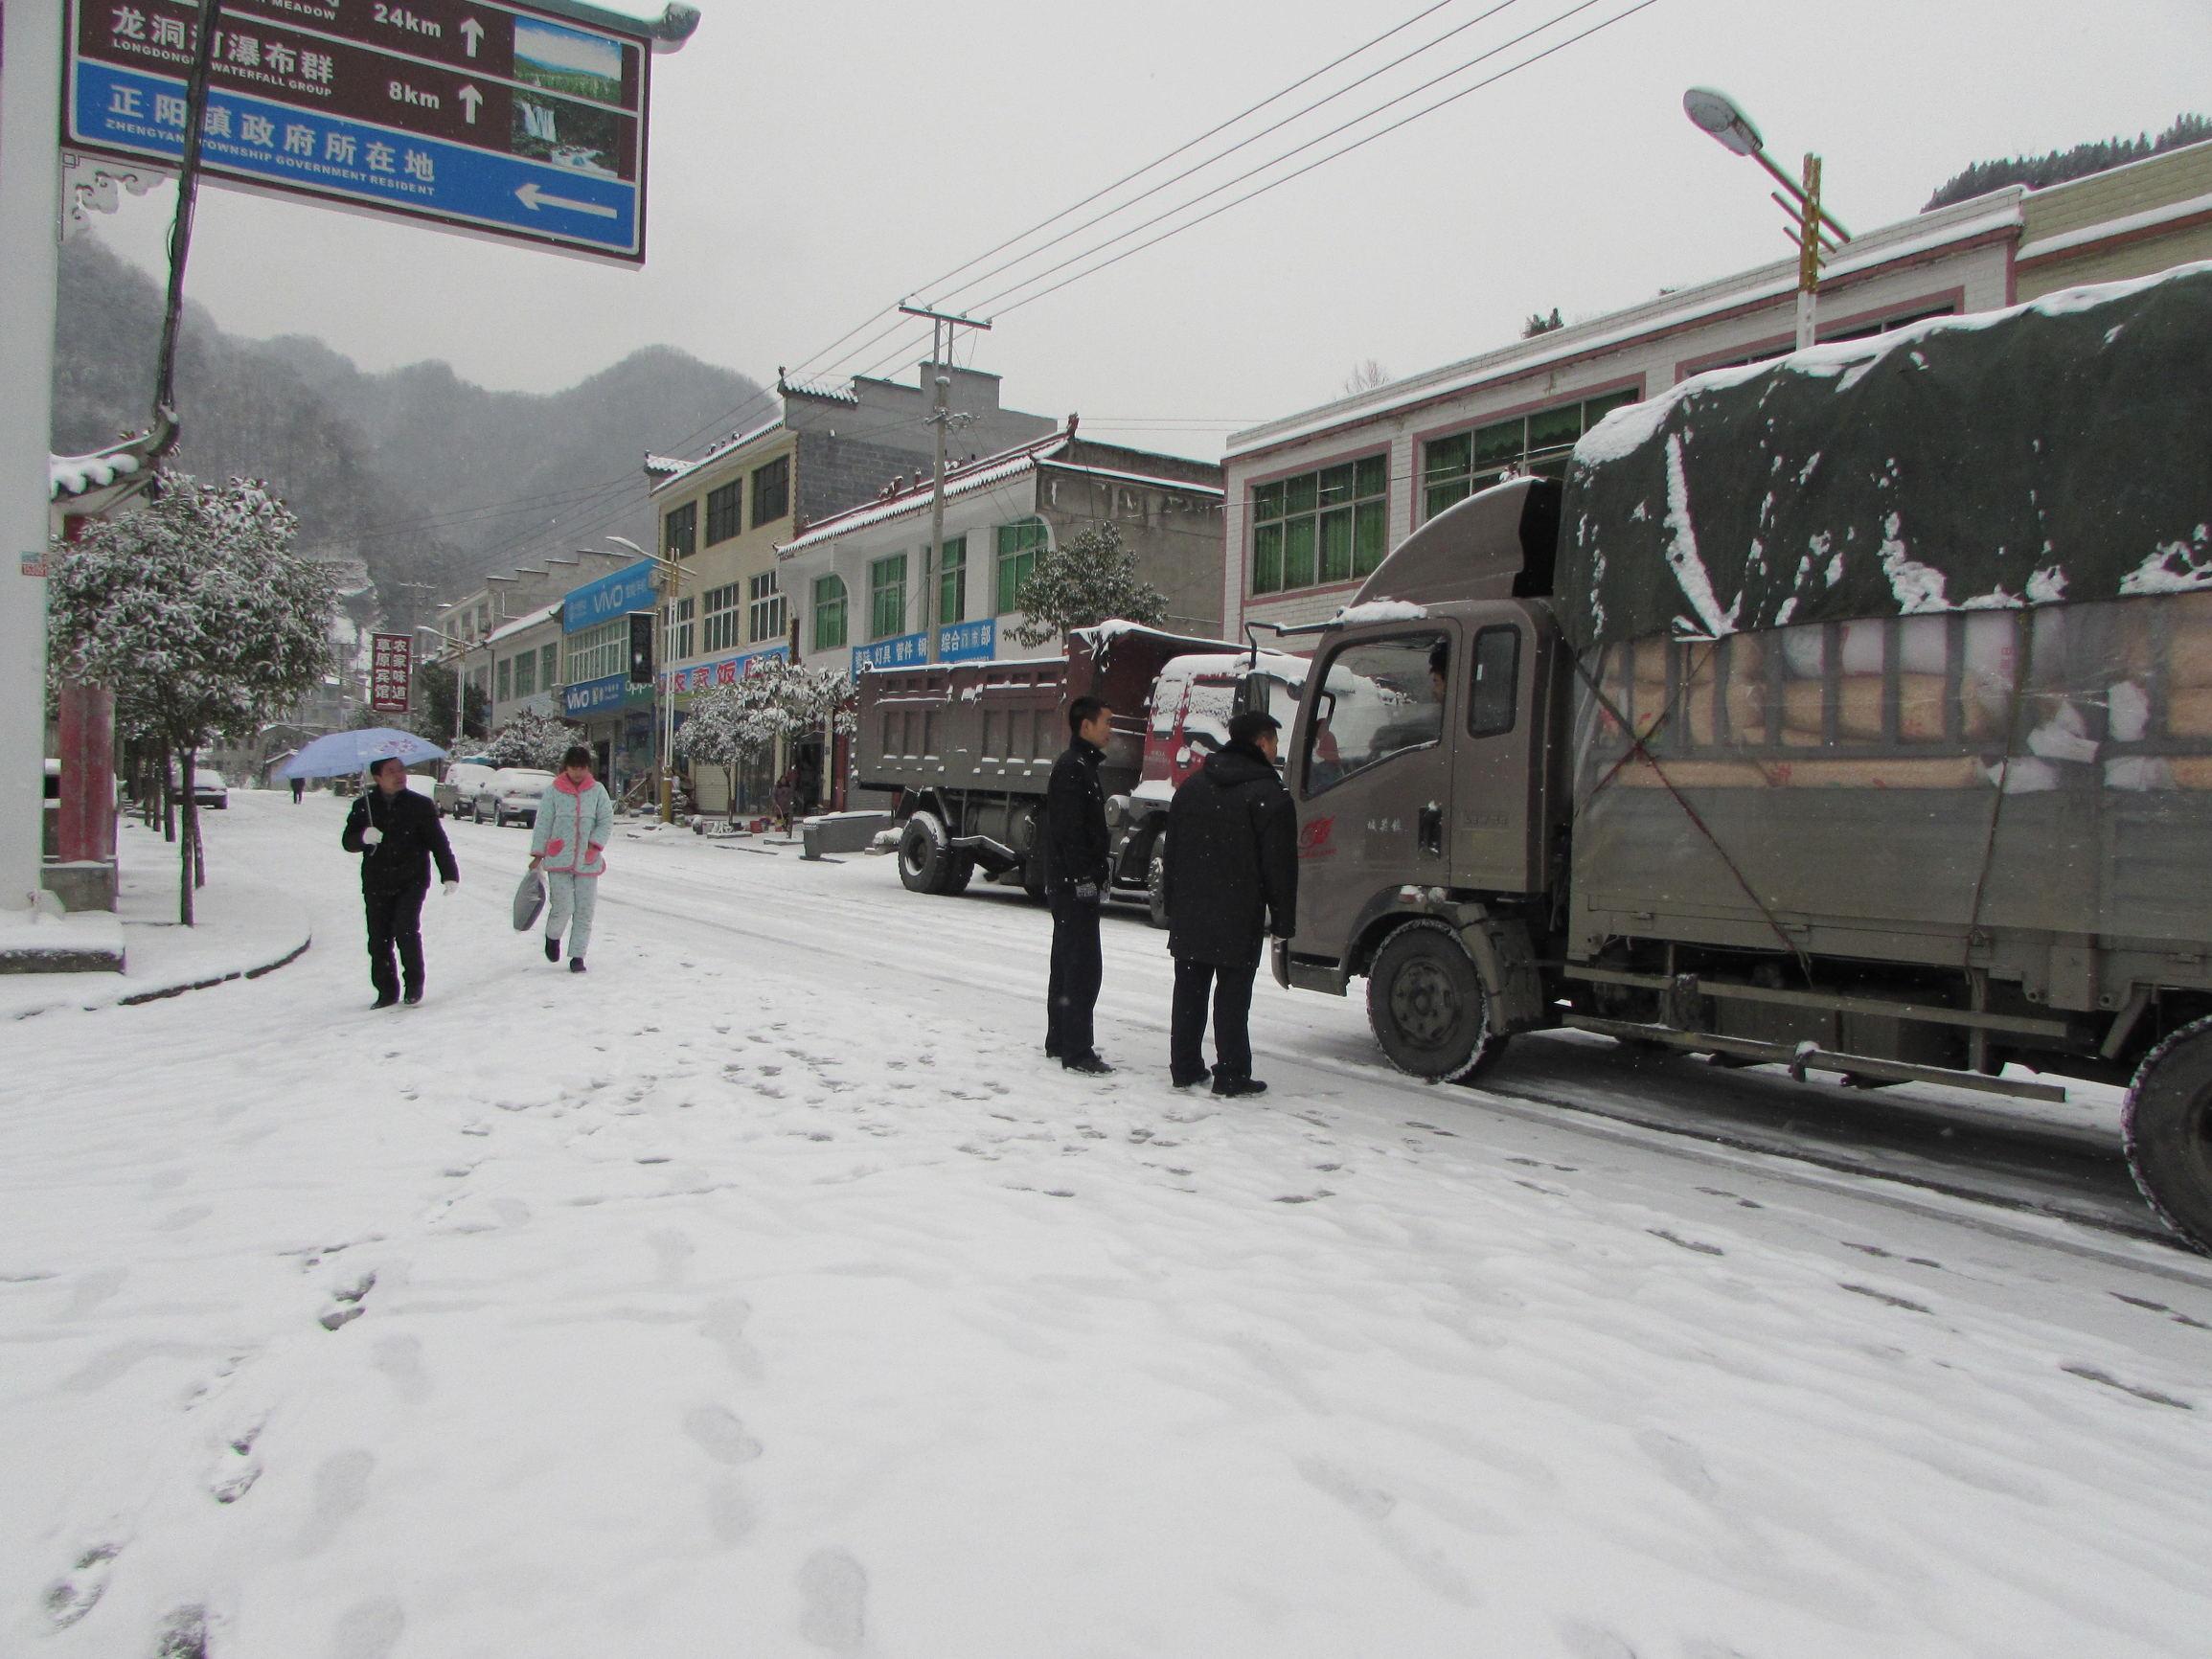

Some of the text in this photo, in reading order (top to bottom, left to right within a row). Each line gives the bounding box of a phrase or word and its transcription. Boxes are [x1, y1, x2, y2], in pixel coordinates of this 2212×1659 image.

[273, 0, 336, 21] MEADOW
[375, 3, 442, 37] 24km
[113, 38, 332, 97] LONGDONG WATERFALL GROUP
[389, 80, 441, 110] 8km
[105, 119, 186, 145] ZHENGYAN
[276, 155, 366, 182] GOVERNMENT
[370, 176, 434, 196] RESIDENT
[107, 84, 435, 184] 正阳镇政府所在地
[392, 640, 406, 699] 农家味道
